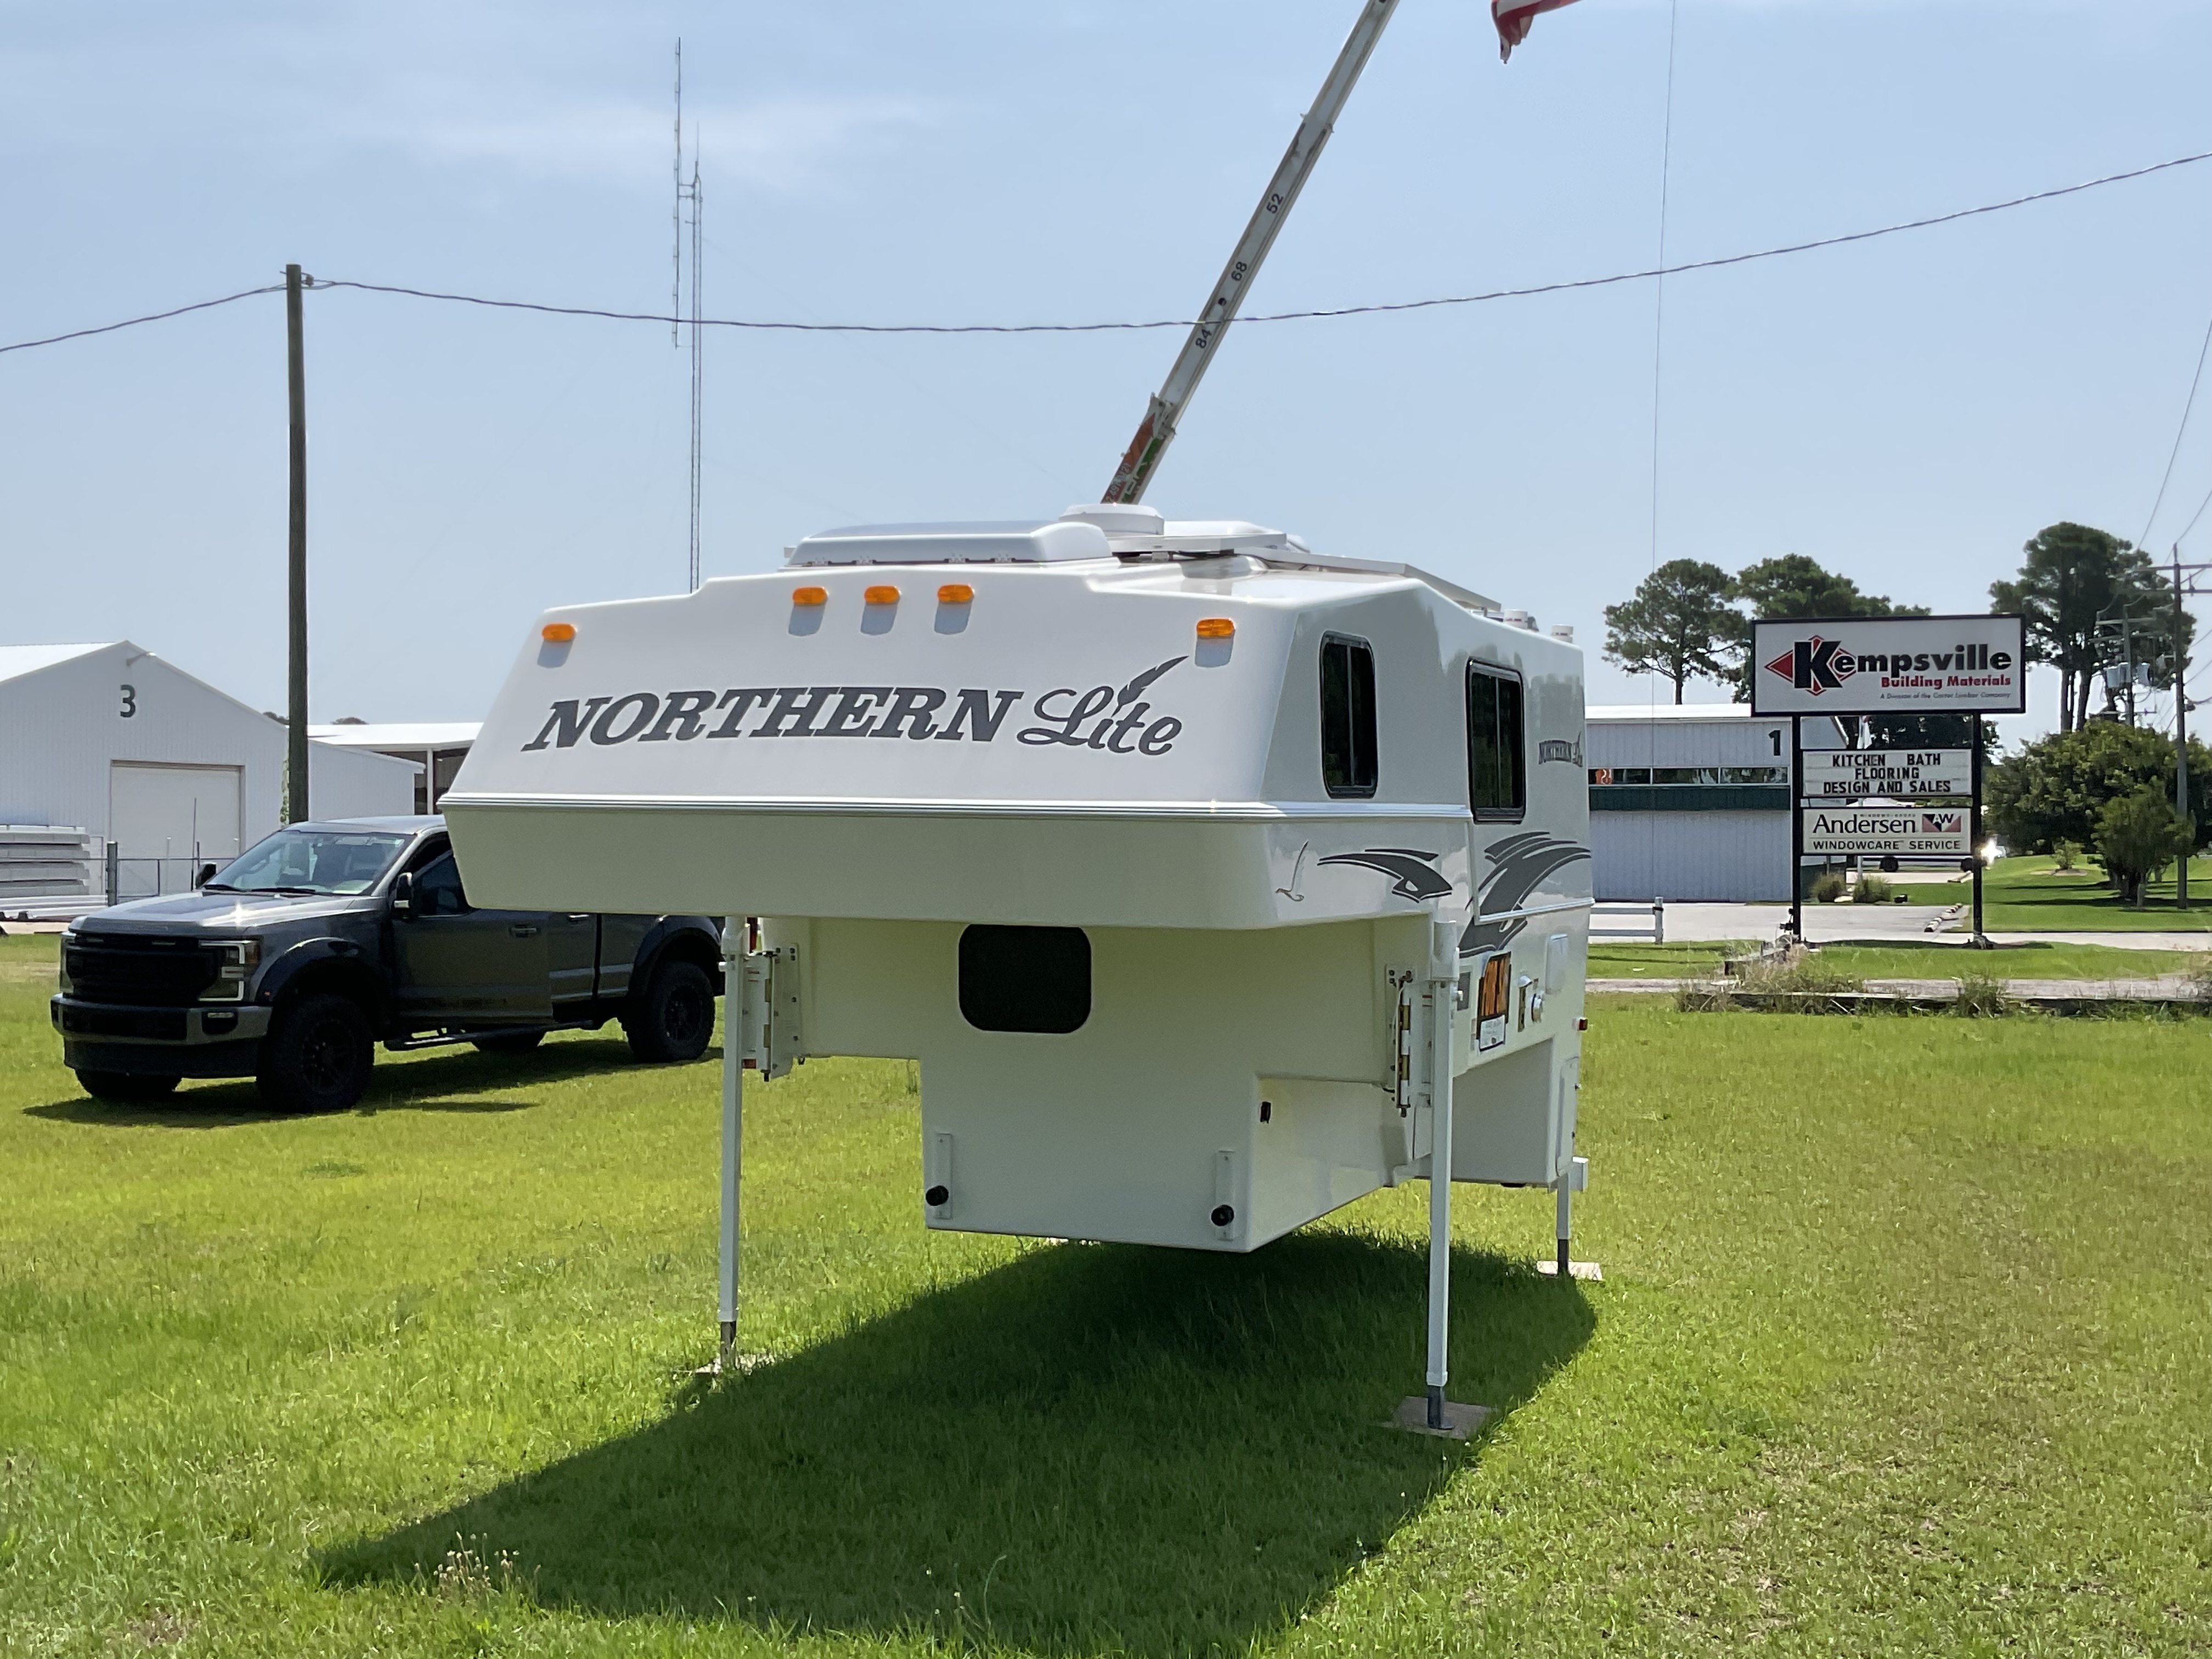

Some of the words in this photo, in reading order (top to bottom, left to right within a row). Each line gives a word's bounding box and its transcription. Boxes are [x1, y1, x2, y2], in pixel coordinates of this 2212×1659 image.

[1267, 194, 1284, 214] 52
[1231, 261, 1247, 281] 68
[1195, 329, 1212, 349] 84
[1795, 641, 2012, 689] Kempsville
[1881, 675, 1943, 690] Building
[1947, 674, 2011, 686] Materials
[120, 684, 136, 718] 3
[521, 687, 1024, 752] NORTHERN
[1017, 685, 1182, 756] Lite
[1768, 730, 1781, 756] 1
[1832, 754, 1886, 767] KITCHEN
[1907, 753, 1941, 766] BATH
[1855, 767, 1919, 780] FLOORING
[1824, 781, 1870, 794] DESIGN
[1877, 781, 1903, 793] AND
[1910, 780, 1951, 793] SALES
[1813, 814, 1916, 833] Andersen
[1909, 840, 1961, 850] SERVICE
